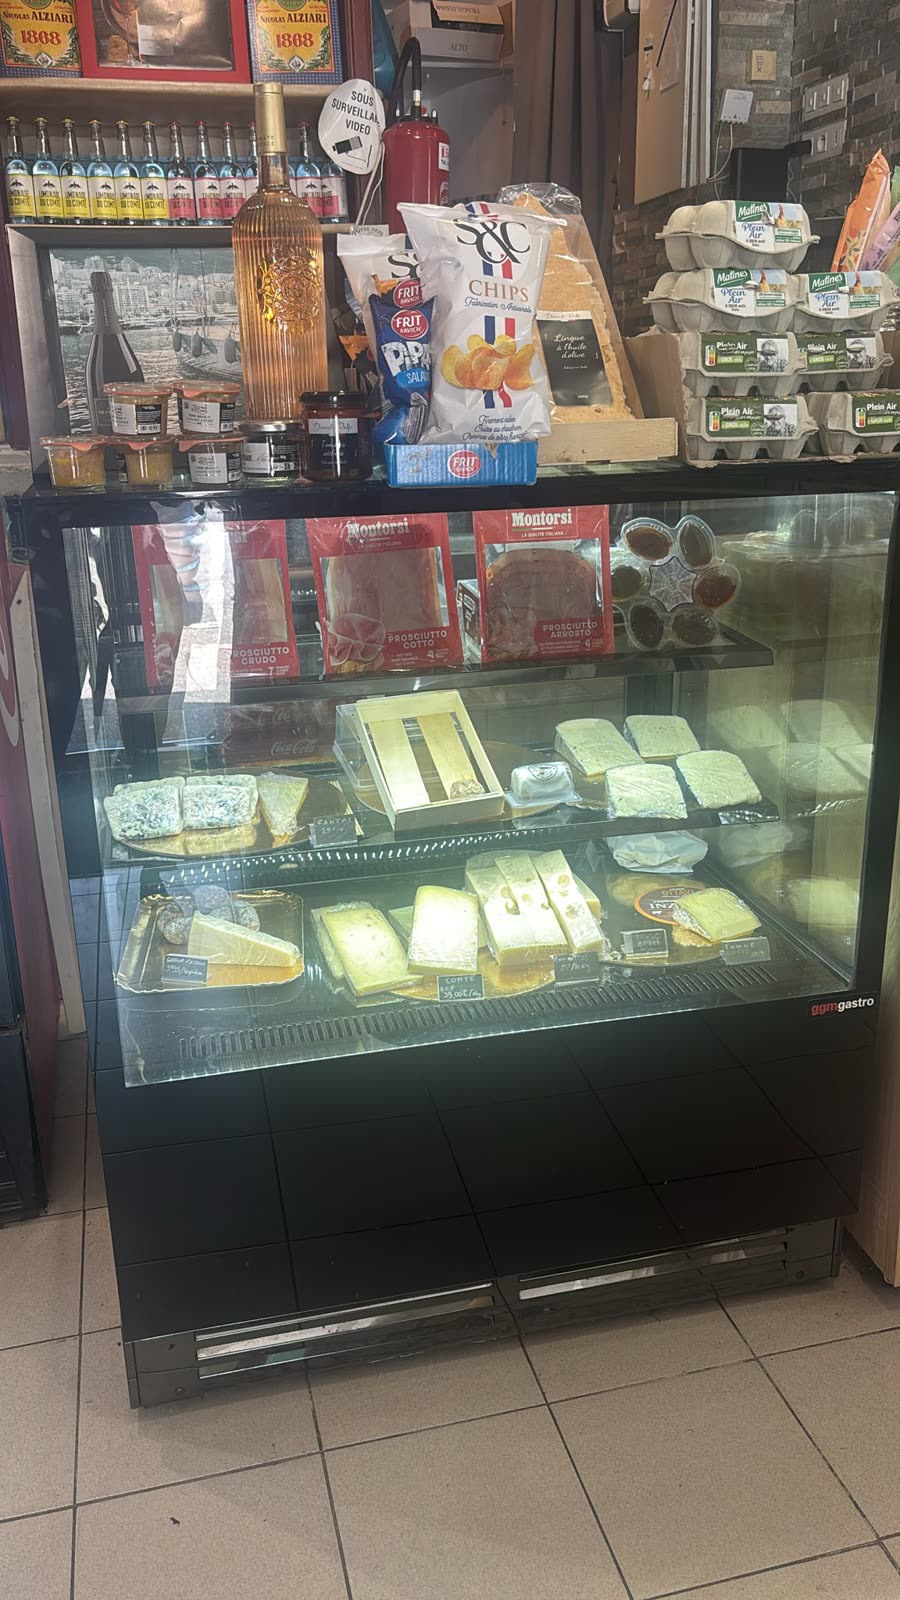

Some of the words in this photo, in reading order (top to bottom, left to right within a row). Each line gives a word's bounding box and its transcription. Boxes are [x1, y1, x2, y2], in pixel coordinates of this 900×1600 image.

[31, 11, 74, 23] ALZIARI
[287, 13, 326, 23] ALZIARI
[21, 30, 61, 45] 1868
[276, 32, 314, 48] 1868
[351, 90, 374, 107] SOUS
[345, 118, 371, 136] VIDEO
[738, 202, 768, 218] Matines
[741, 223, 765, 232] Plein
[748, 231, 762, 239] Air
[717, 270, 748, 285] Matines
[811, 274, 843, 290] Matines
[397, 285, 420, 299] FRIT
[468, 280, 529, 303] CHIPS
[720, 288, 747, 297] Plein
[815, 293, 840, 301] Plein
[396, 314, 422, 328] FRIT
[554, 334, 585, 344] Lingue
[737, 342, 748, 350] Air
[721, 407, 741, 415] Plein
[866, 403, 885, 411] Plein
[886, 402, 898, 410] Air
[453, 456, 478, 467] FRIT
[511, 508, 573, 527] Montorsi
[347, 517, 410, 539] Montorsi
[542, 621, 598, 631] PROSCIUTTO
[388, 630, 448, 643] PROSCIUTTO
[550, 629, 592, 639] ARROSTO
[403, 639, 435, 649] COTTO
[232, 646, 290, 658] ROSCIUTTO
[241, 655, 277, 665] CRUDO
[811, 997, 875, 1016] ggmgastro
